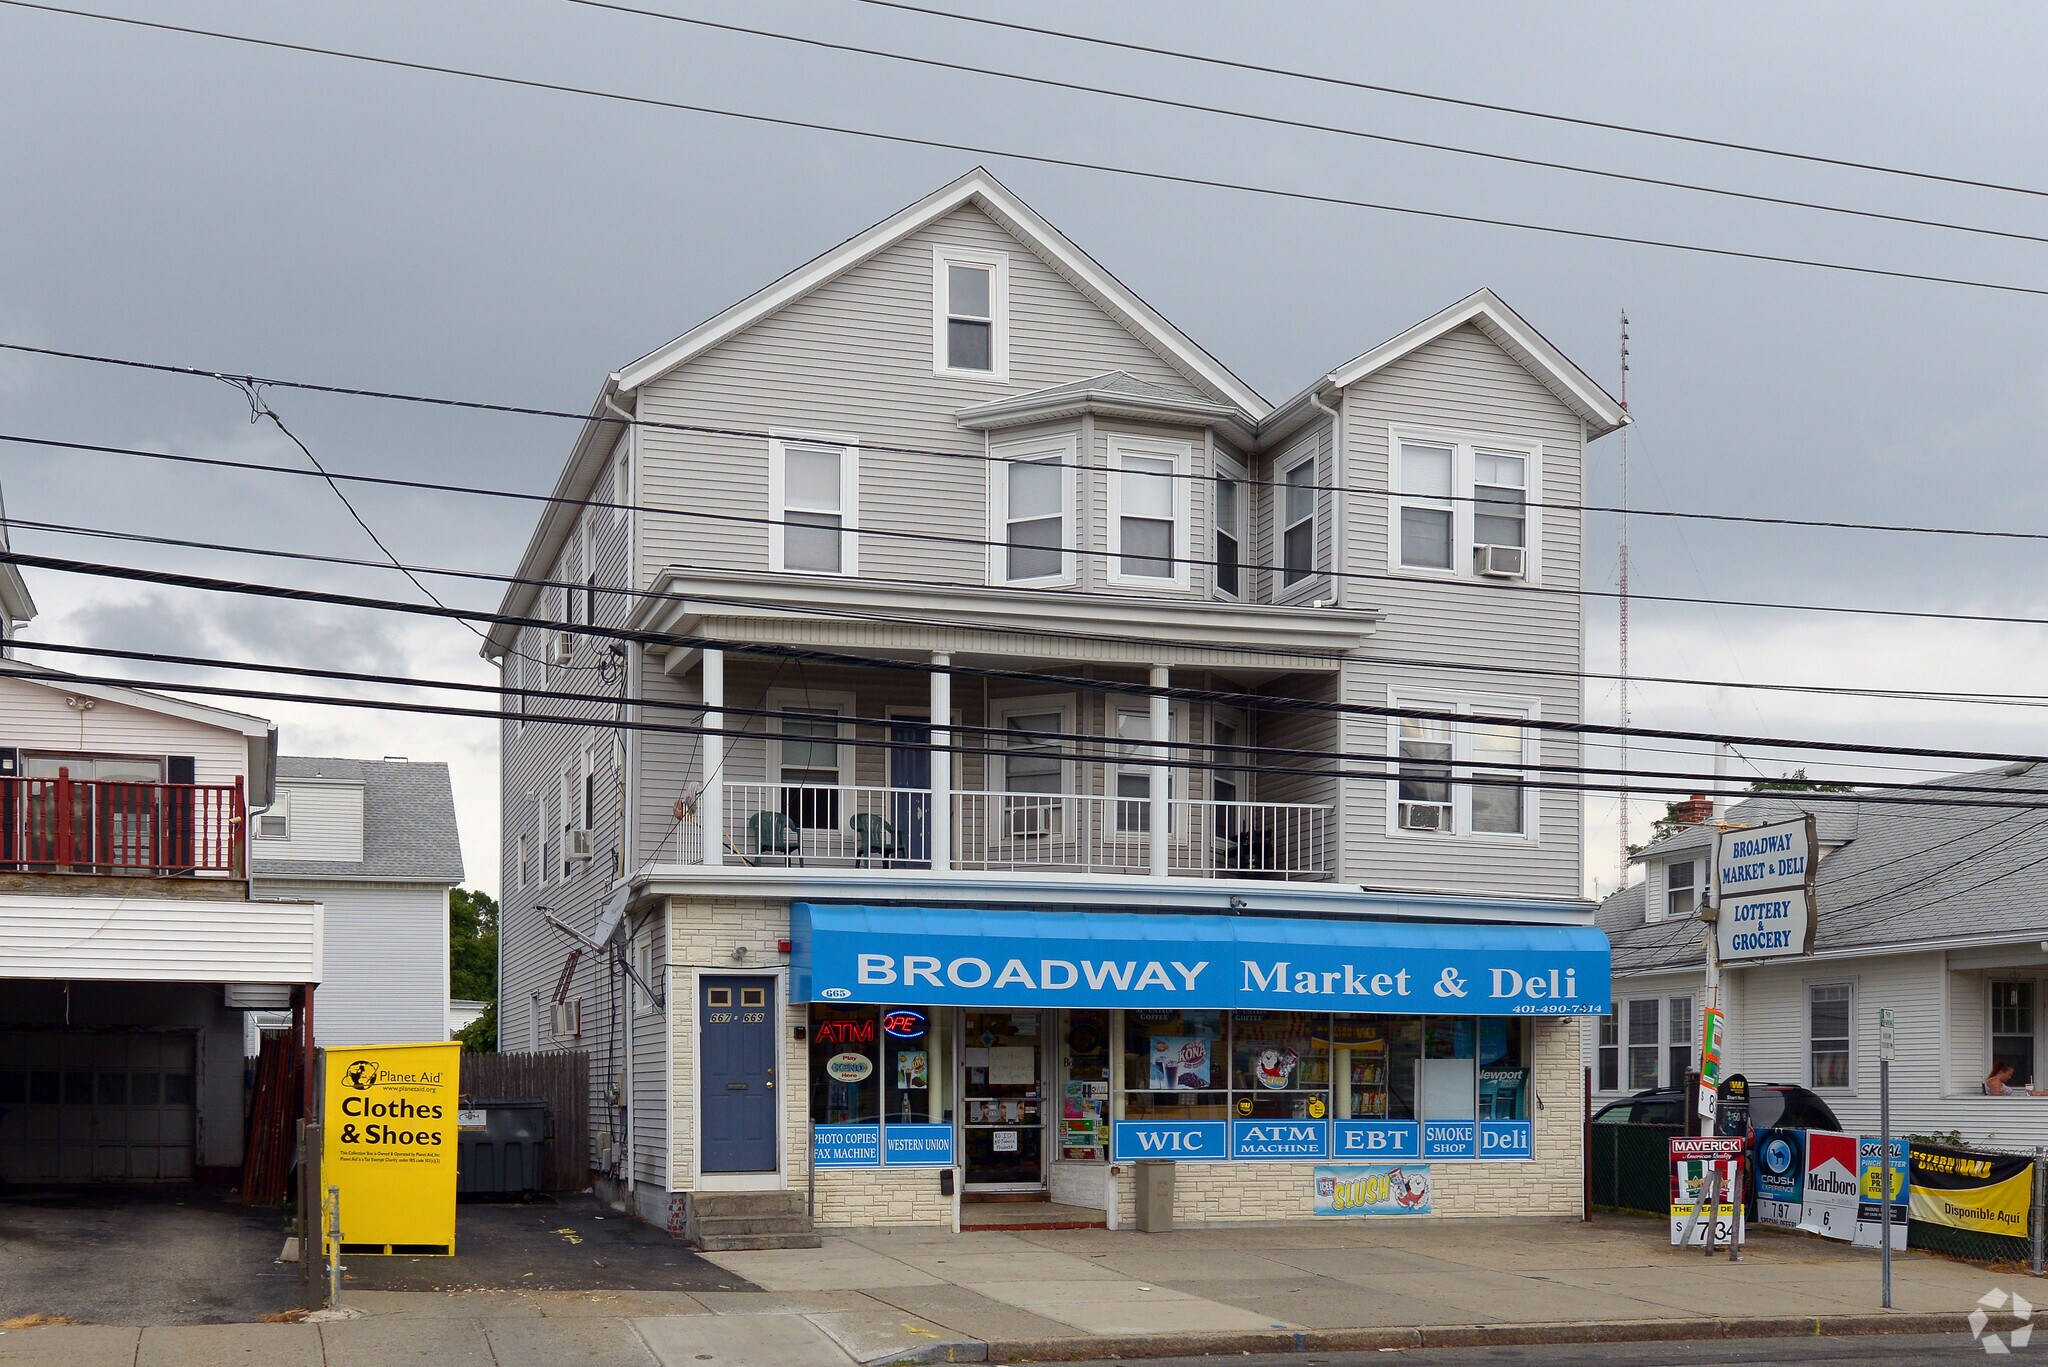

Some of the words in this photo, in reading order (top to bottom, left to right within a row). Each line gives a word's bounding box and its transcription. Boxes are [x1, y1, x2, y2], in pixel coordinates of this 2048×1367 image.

[1732, 833, 1793, 859] BROADWAY
[1722, 862, 1765, 885] MARKET
[1768, 863, 1776, 875] &
[1778, 856, 1805, 877] DELI
[1734, 900, 1791, 922] LOTTERY
[1757, 921, 1764, 932] &
[1732, 930, 1792, 951] GROCERY
[857, 953, 1210, 992] BROADWAY
[1240, 959, 1412, 997] Market
[1433, 966, 1468, 998] &
[1488, 967, 1578, 999] Deli
[711, 1013, 731, 1022] 667
[744, 1013, 763, 1022] 669
[816, 1020, 875, 1044] ATM
[833, 1062, 865, 1073] KENO
[380, 1070, 416, 1082] Planet
[420, 1072, 441, 1083] Aid
[341, 1096, 443, 1119] Clothes
[340, 1123, 361, 1144] &
[365, 1124, 442, 1146] Shoes
[845, 1133, 877, 1144] COPIES
[1136, 1131, 1203, 1151] WIC
[1242, 1126, 1318, 1141] ATM
[1344, 1130, 1409, 1150] EBT
[1426, 1127, 1473, 1141] SMOKE
[1482, 1129, 1528, 1149] Deli
[888, 1139, 924, 1151] WESTERN
[925, 1138, 949, 1151] UNION
[1240, 1144, 1319, 1153] MACHINE
[1433, 1143, 1466, 1153] SHOP
[1674, 1141, 1739, 1151] MAVERICK
[833, 1148, 877, 1159] MACHINE
[1918, 1161, 1954, 1173] UNION
[1960, 1159, 1992, 1179] WU
[1761, 1174, 1795, 1186] CRUSH
[1807, 1171, 1857, 1196] Marlboro
[1332, 1174, 1391, 1210] SLUSH
[1761, 1184, 1795, 1193] EXPERIENCE
[1771, 1202, 1790, 1220] 7.97
[1807, 1208, 1812, 1216] $
[1944, 1202, 1995, 1220] Disponible
[1997, 1210, 2020, 1225] Aquí
[1675, 1221, 1683, 1232] $
[1859, 1223, 1863, 1232] $
